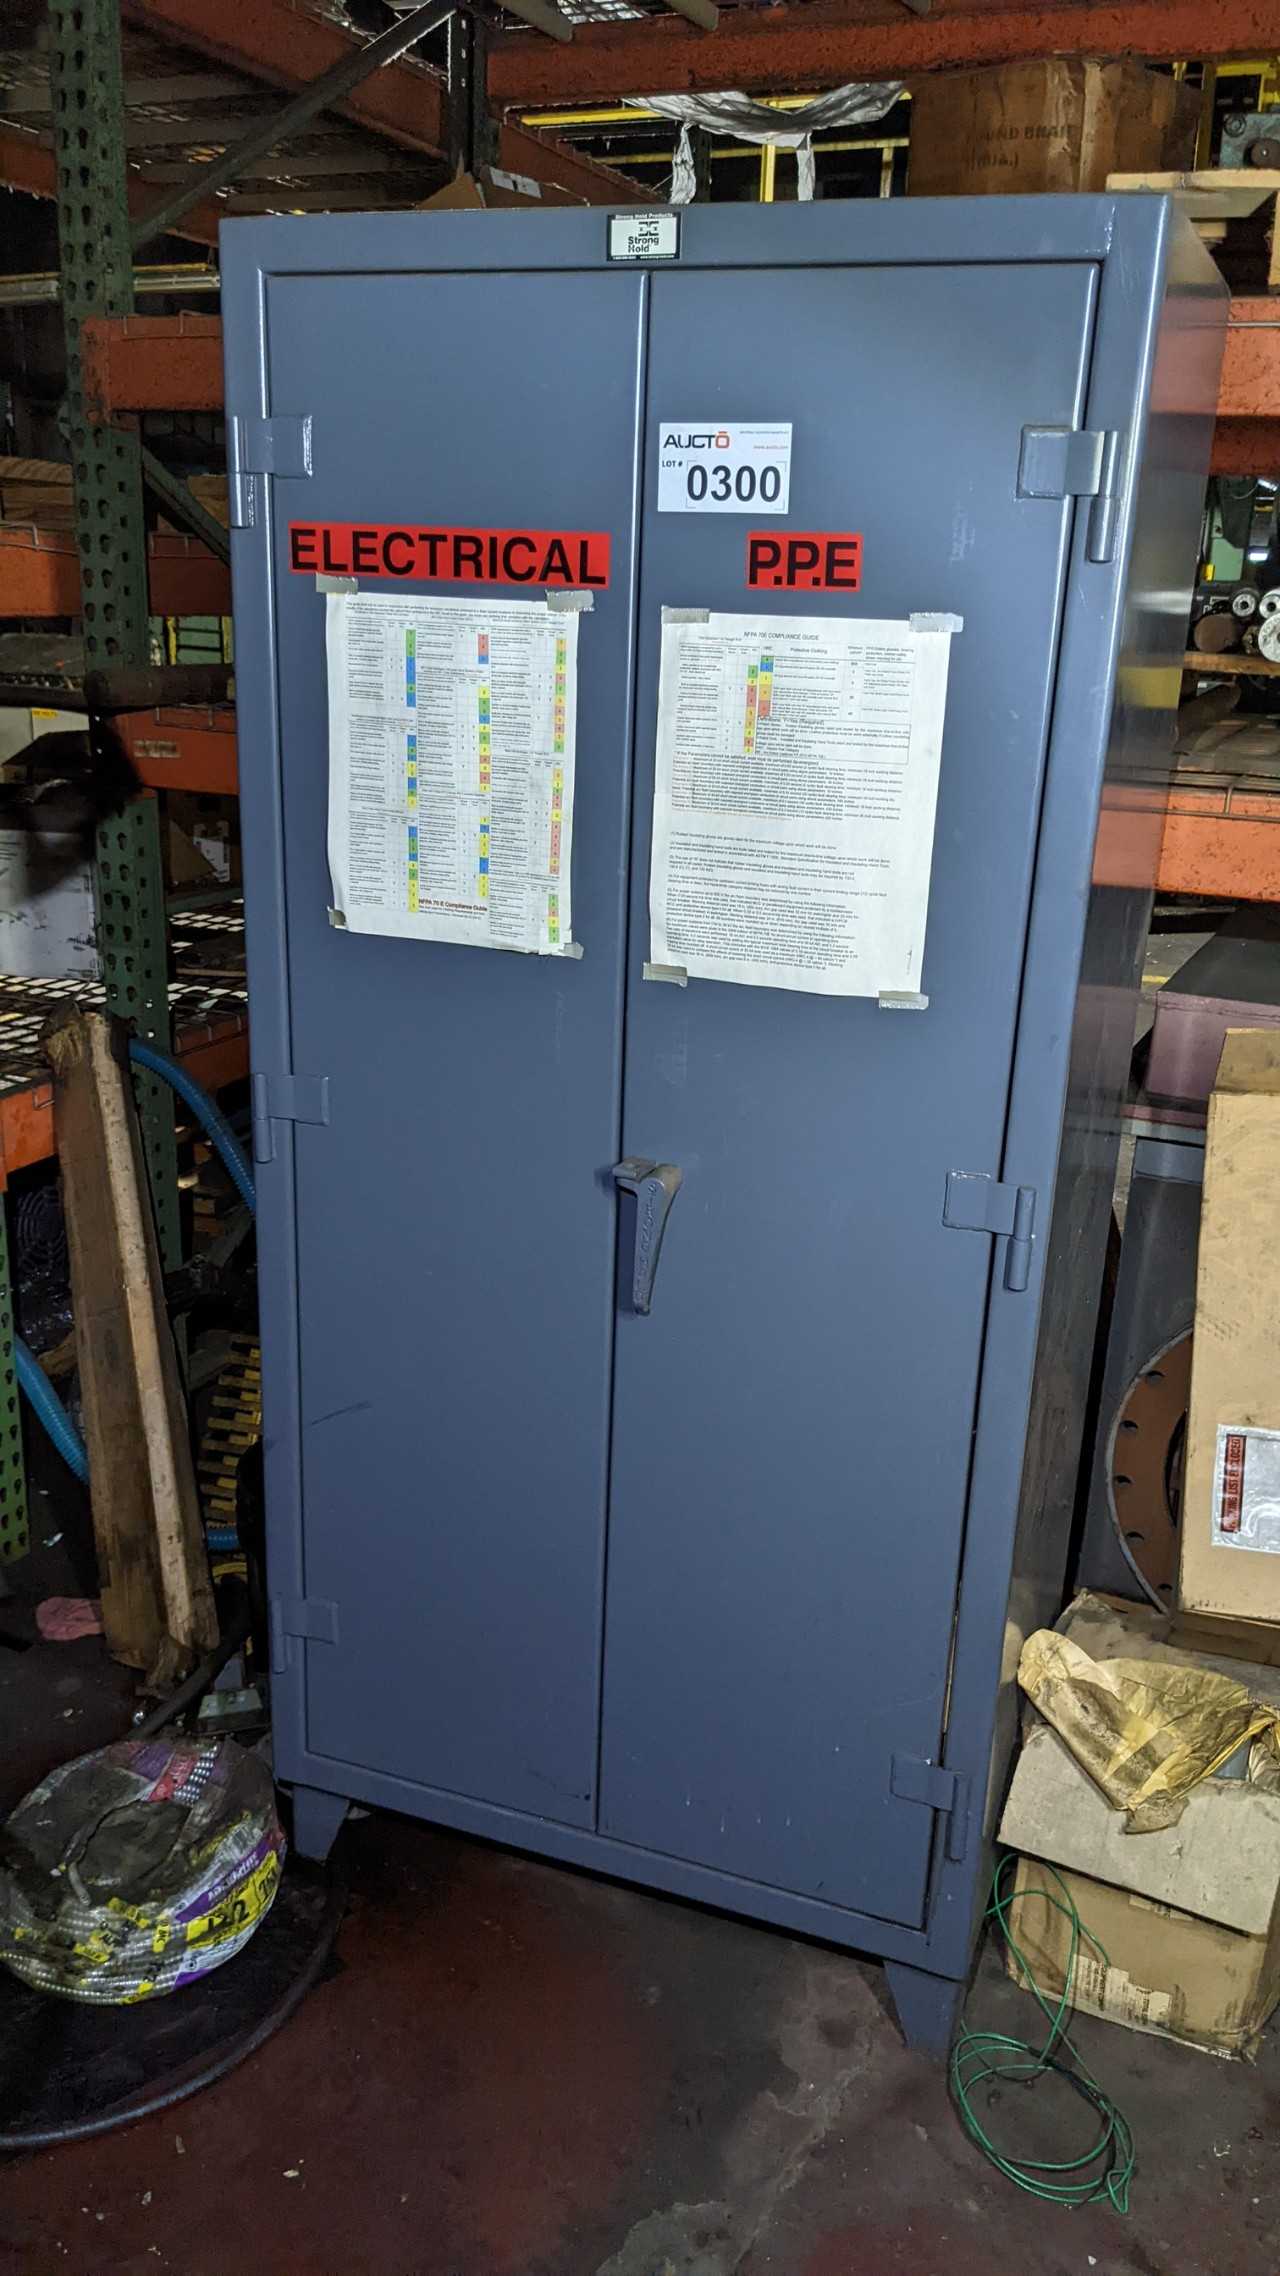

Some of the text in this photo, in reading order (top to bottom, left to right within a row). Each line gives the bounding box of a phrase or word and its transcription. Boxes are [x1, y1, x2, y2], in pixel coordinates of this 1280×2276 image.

[627, 236, 660, 246] Strong
[627, 244, 650, 254] Hold
[661, 460, 676, 468] LOT
[687, 464, 781, 502] 0300
[290, 527, 606, 585] ELECTRICAL
[749, 539, 858, 588] P.P.E
